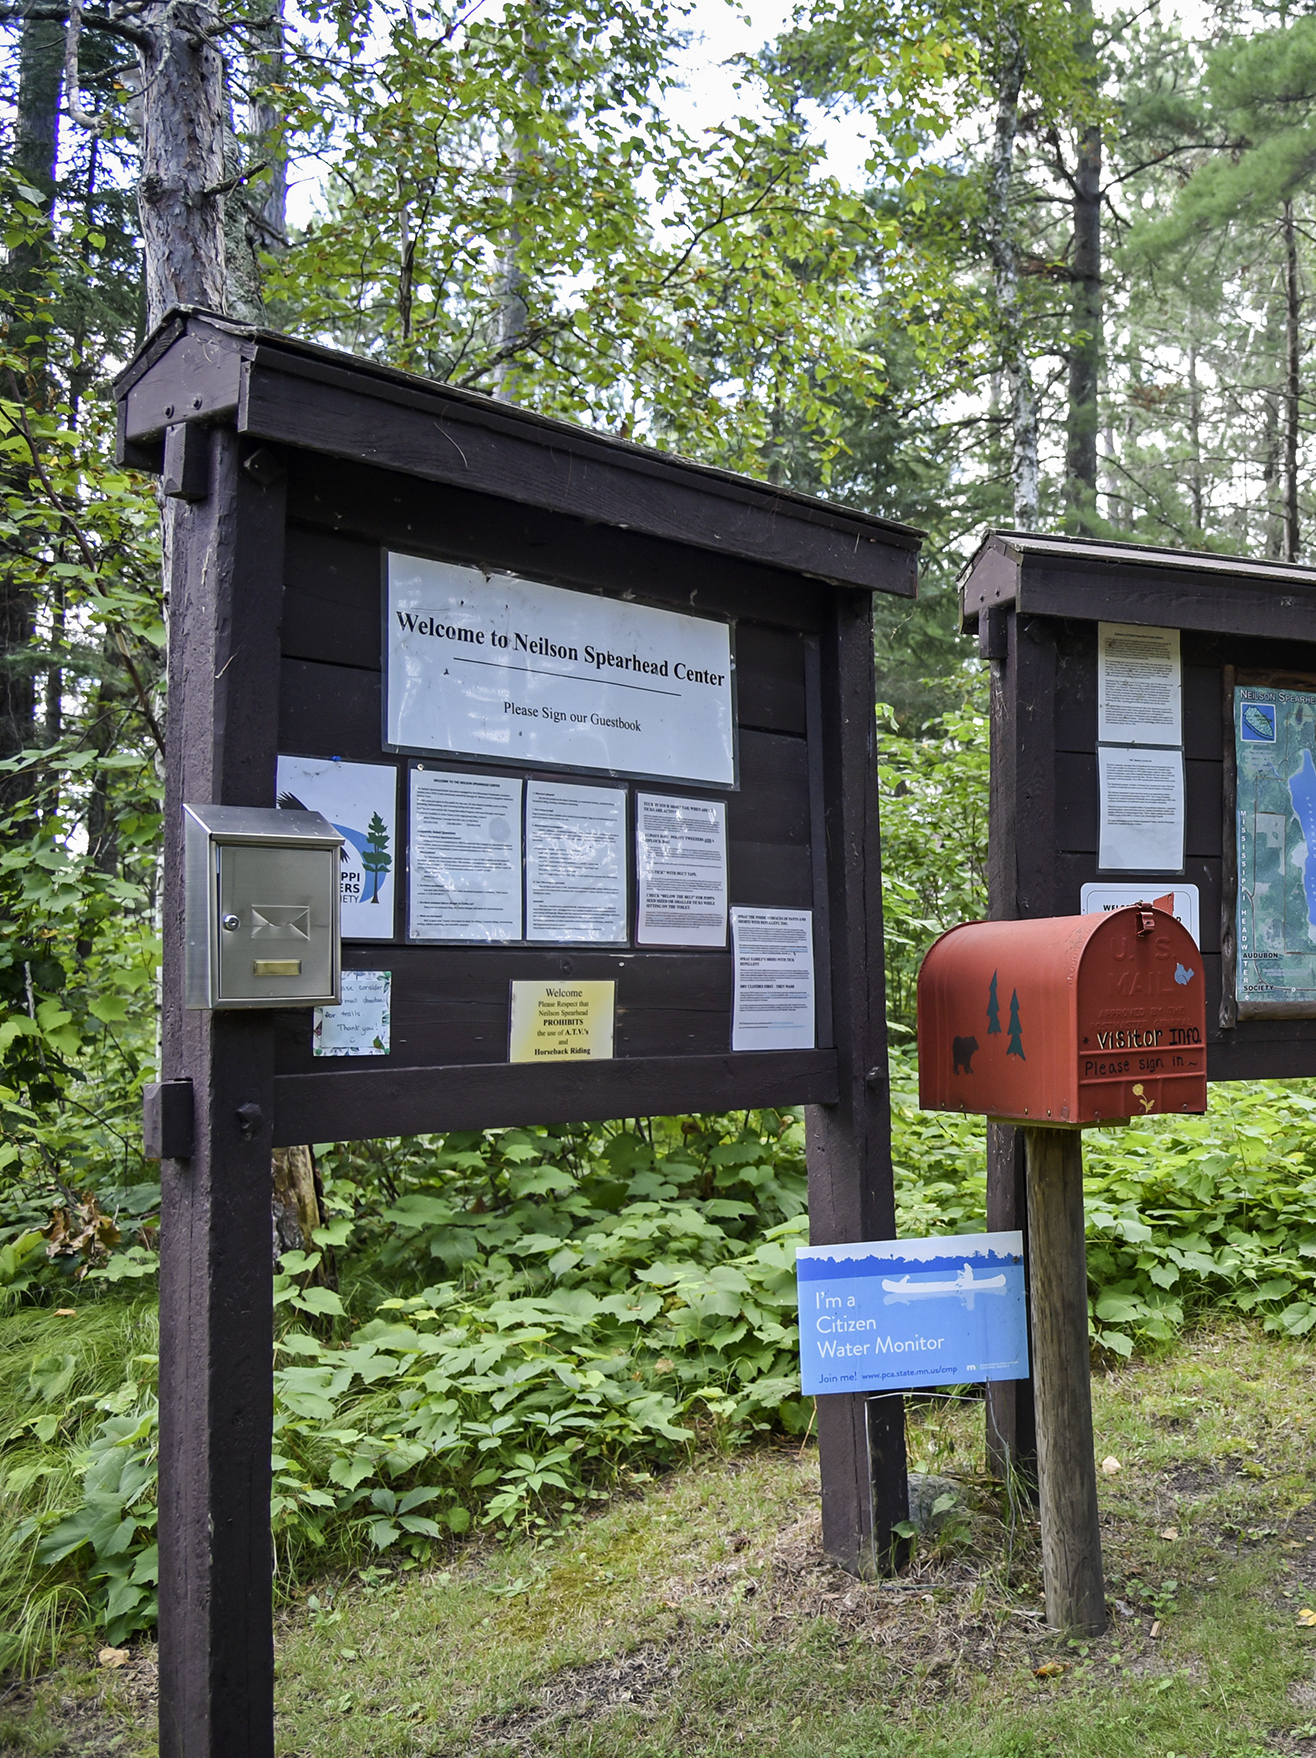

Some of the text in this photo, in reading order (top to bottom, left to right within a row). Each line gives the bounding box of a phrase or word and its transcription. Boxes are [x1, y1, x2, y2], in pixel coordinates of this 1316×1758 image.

[397, 611, 725, 687] Welcome to Neilson Spearhead Center
[1240, 689, 1275, 700] NEILSON
[504, 702, 641, 732] Please Sign our Guestbook
[546, 988, 583, 997] Welcome
[557, 1001, 578, 1009] Respect
[561, 1010, 588, 1018] Spearhead
[570, 1047, 591, 1055] Riding
[1085, 1055, 1184, 1076] Please sign in
[816, 1292, 856, 1309] I'm a
[816, 1315, 876, 1334] Citizen
[817, 1334, 945, 1359] Water Monitor
[819, 1365, 958, 1384] Join me! www.pca.state.mn.us/cmp
